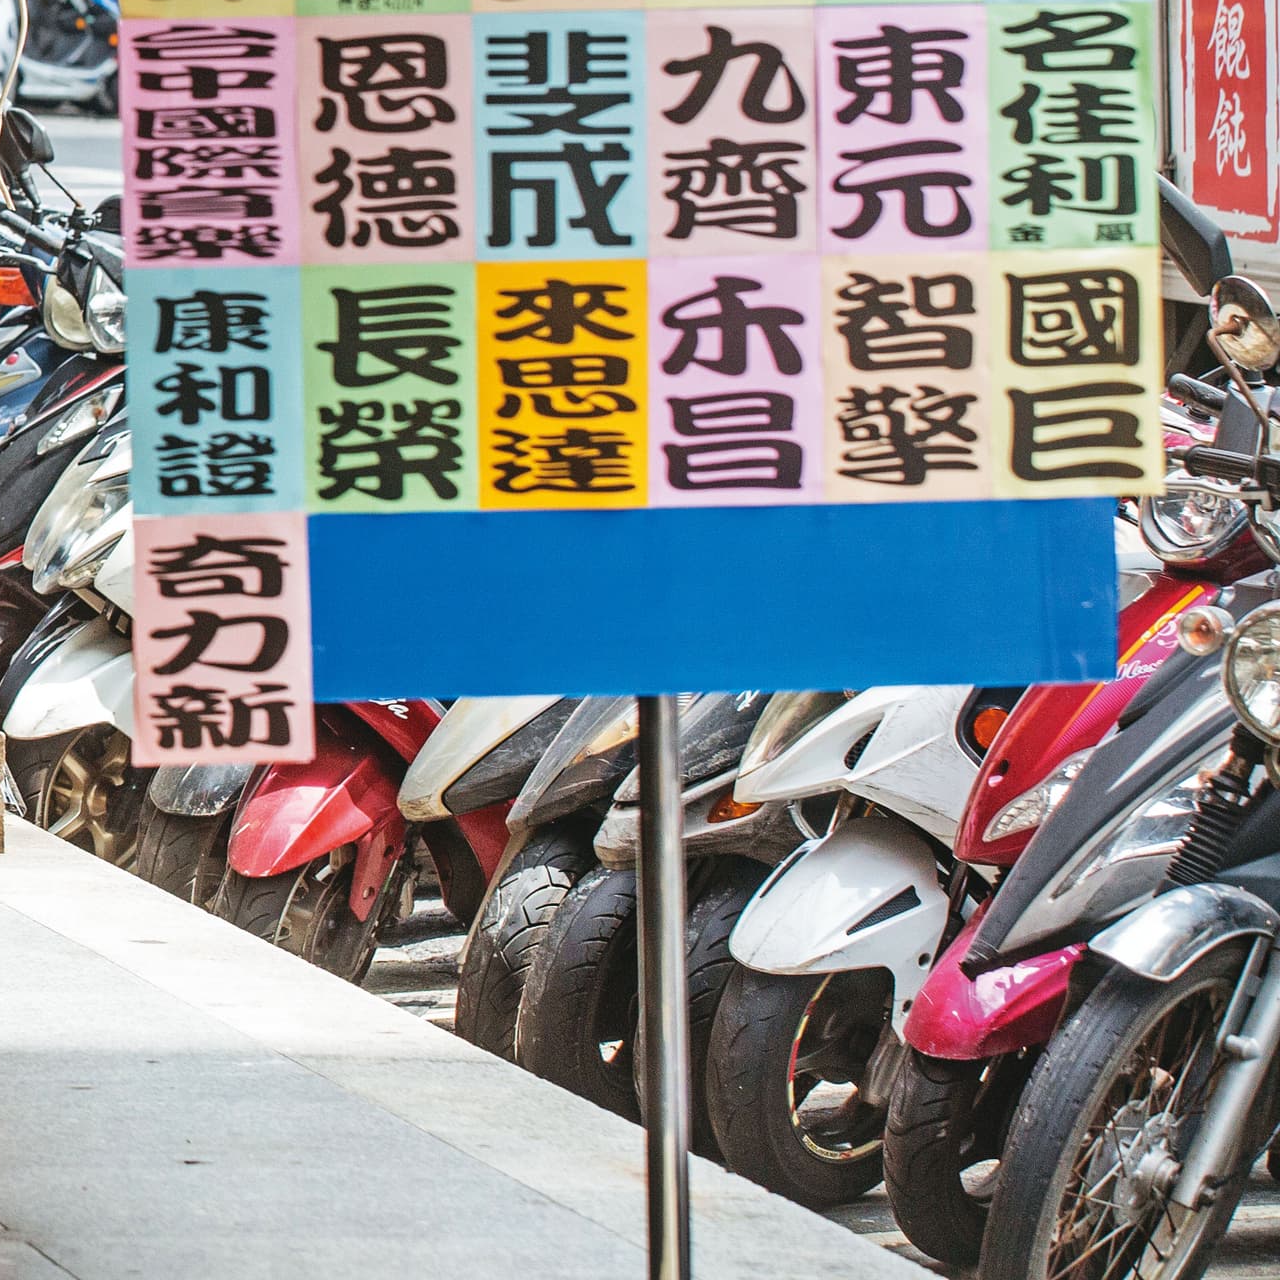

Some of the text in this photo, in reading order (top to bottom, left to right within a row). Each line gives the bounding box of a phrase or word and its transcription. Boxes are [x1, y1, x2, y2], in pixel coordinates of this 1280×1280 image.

[133, 26, 281, 260] 台中國際育樂
[313, 34, 460, 248] 恩德
[485, 31, 632, 248] 斐成
[663, 26, 807, 239] 九齊
[832, 25, 972, 239] 東元
[154, 290, 275, 498] 康和證
[316, 284, 463, 501] 長榮
[494, 280, 637, 493] 來思達
[662, 277, 804, 490] 禾昌
[837, 273, 978, 486] 智擎
[1006, 269, 1145, 482] 國巨
[151, 535, 294, 749] 奇力新
